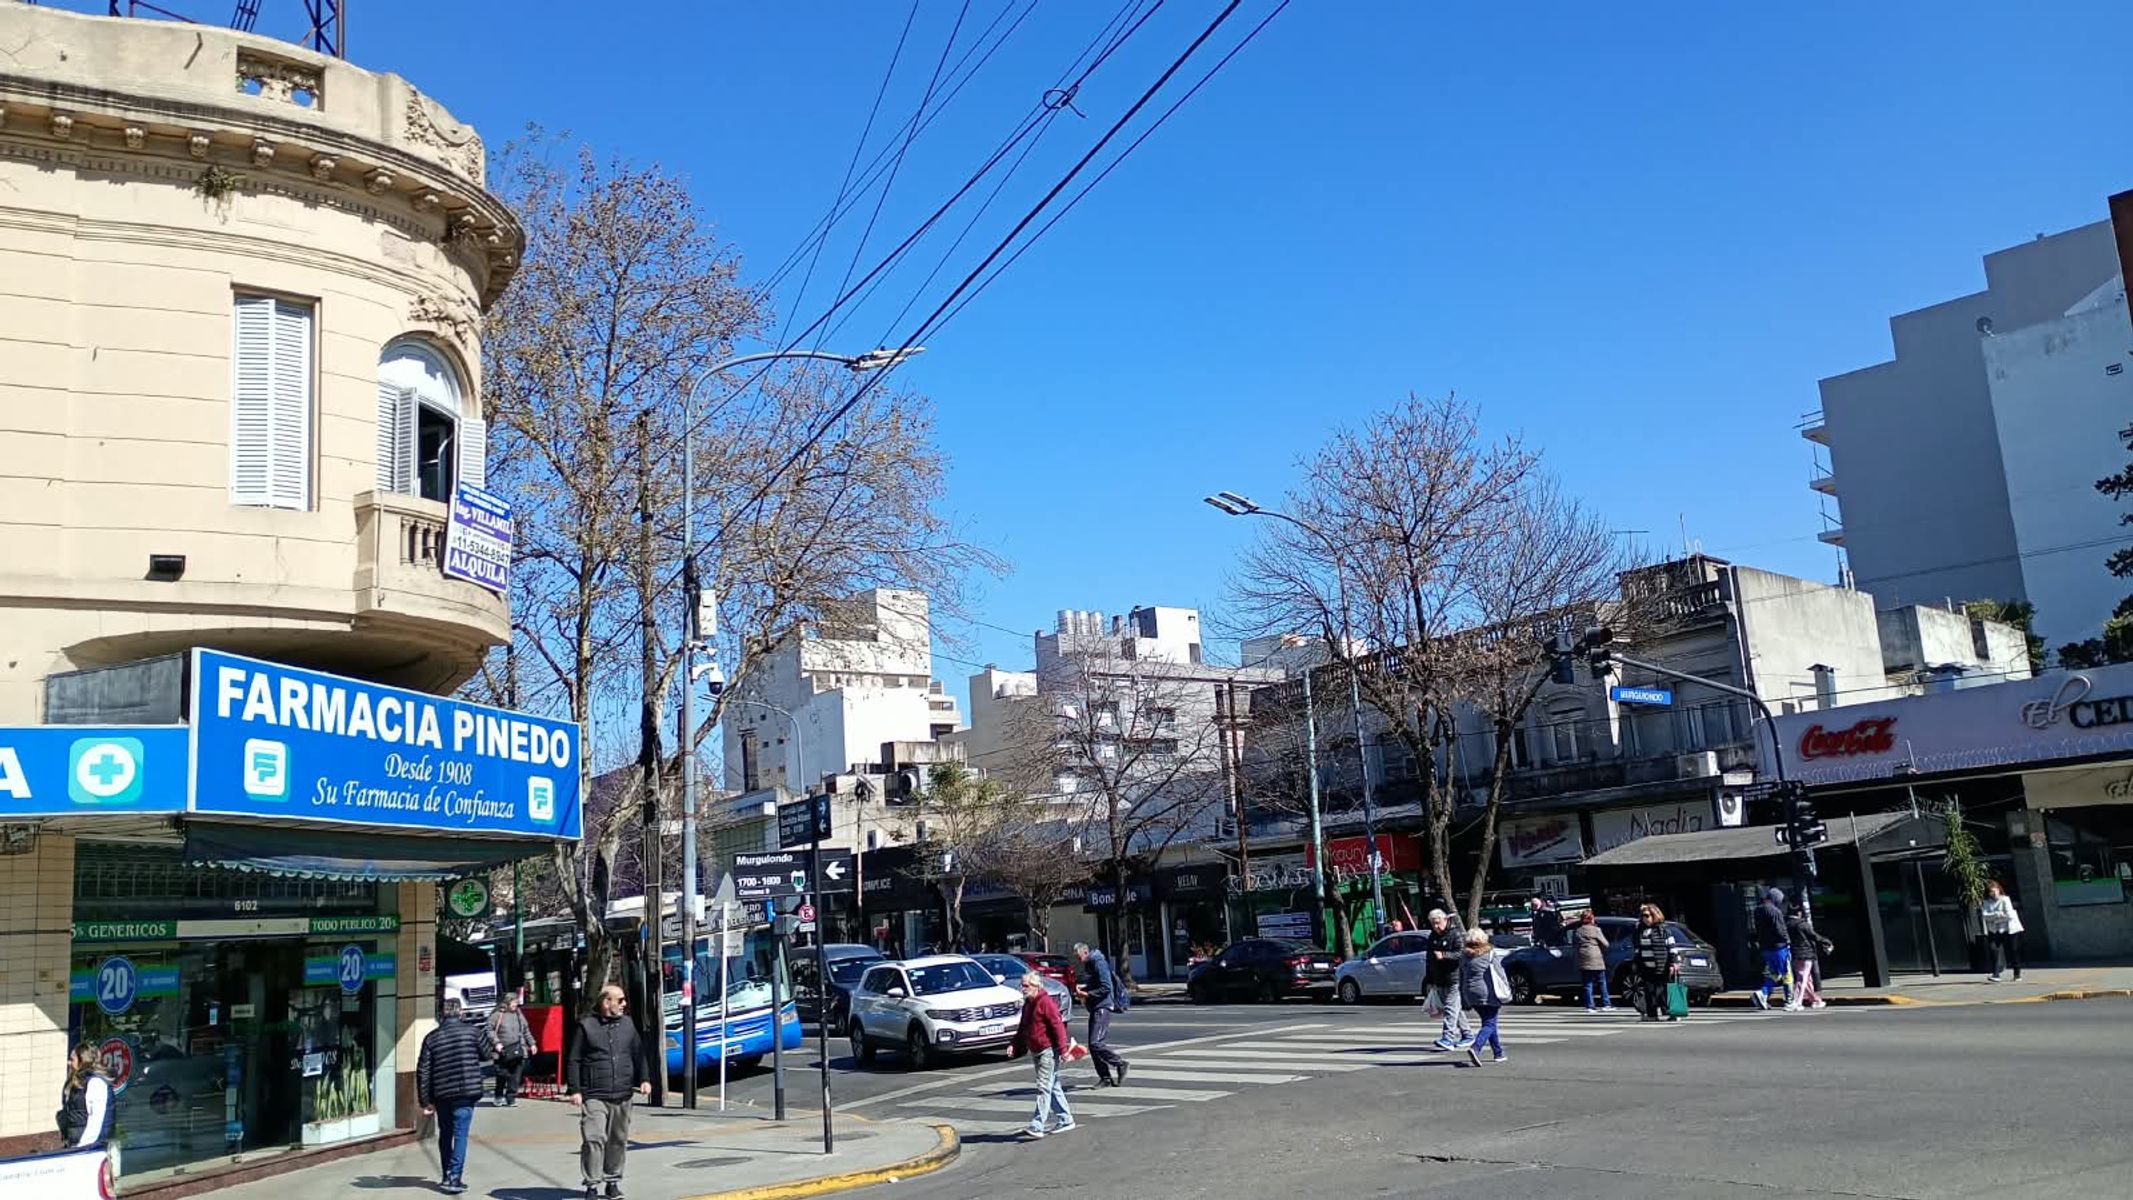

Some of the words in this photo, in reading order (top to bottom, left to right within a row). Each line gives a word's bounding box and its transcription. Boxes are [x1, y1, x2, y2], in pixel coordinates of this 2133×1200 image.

[450, 549, 506, 585] ALQUILA
[217, 665, 443, 750] FARMACIA
[453, 709, 571, 769] PINEDO
[384, 752, 433, 782] Desde
[438, 761, 473, 786] 1908
[312, 777, 338, 806] Su
[343, 780, 420, 811] Farmacia
[424, 787, 442, 812] de
[445, 789, 515, 824] Confianza
[234, 900, 258, 912] 6102
[312, 919, 338, 931] TODO
